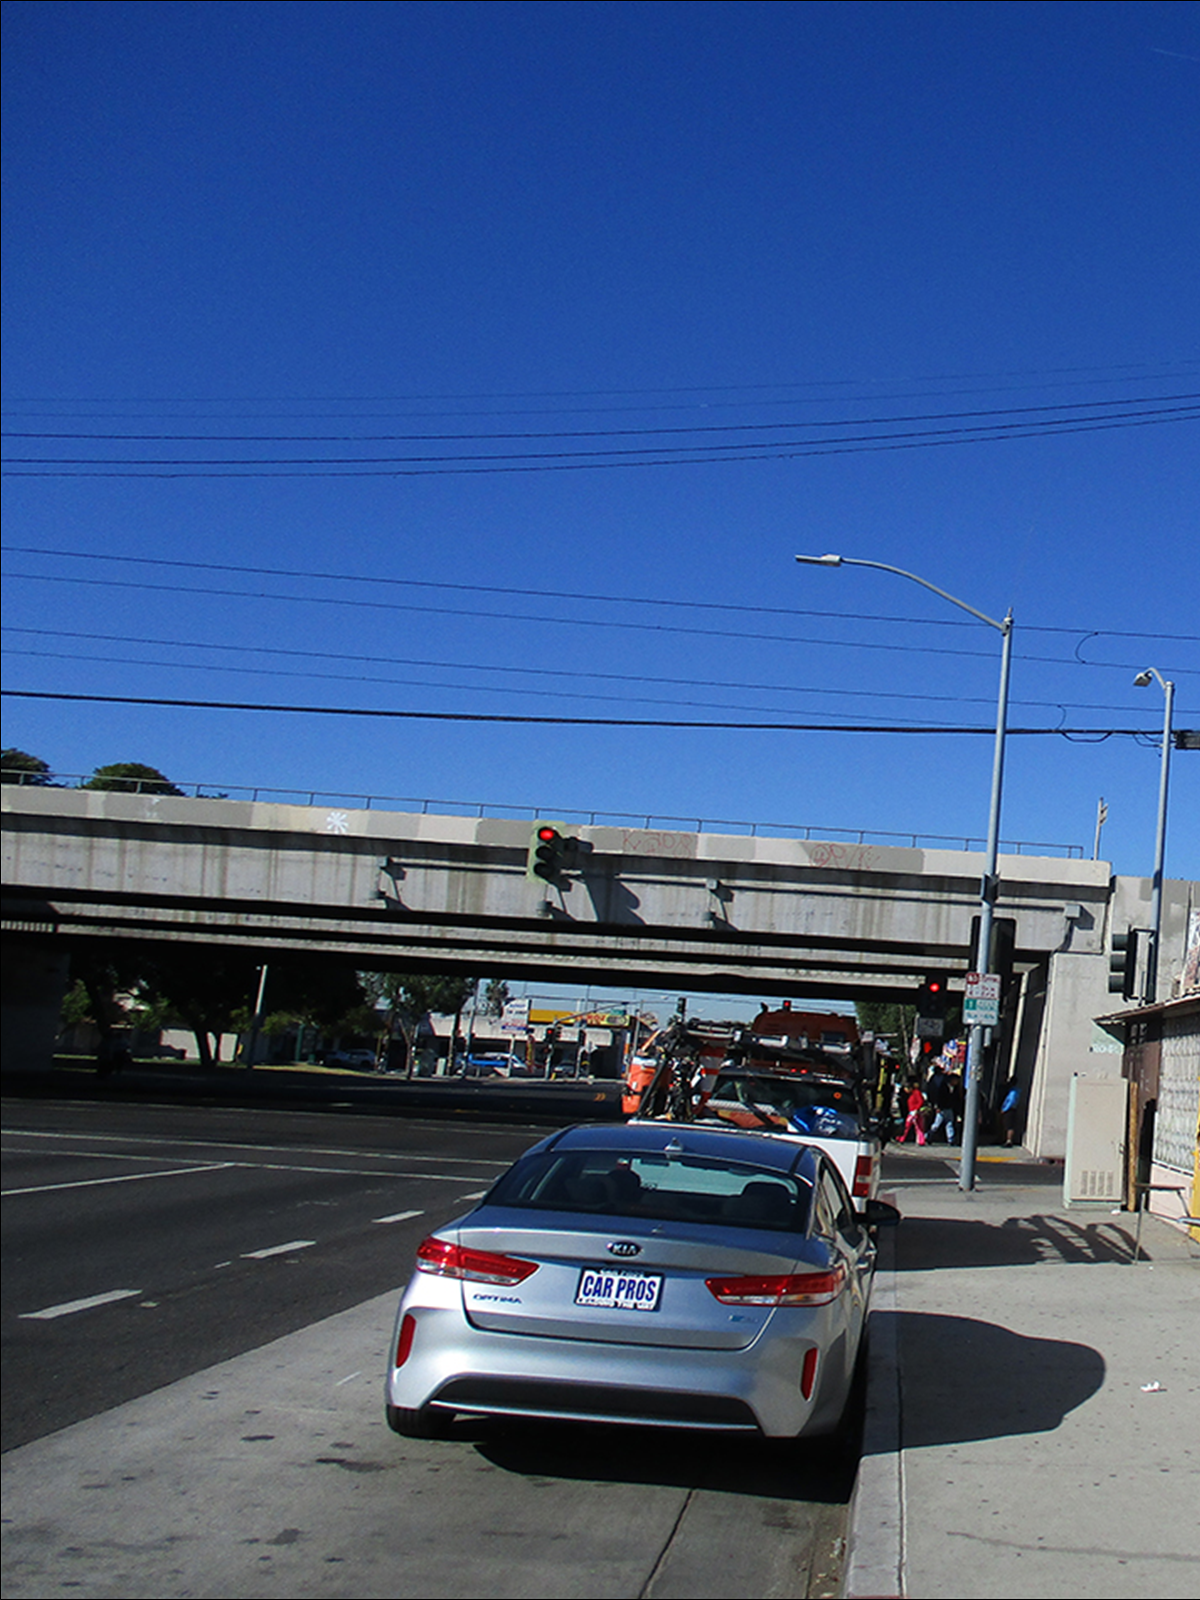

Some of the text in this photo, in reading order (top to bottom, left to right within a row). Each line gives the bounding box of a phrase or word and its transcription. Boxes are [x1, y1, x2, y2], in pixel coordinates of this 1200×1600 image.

[612, 1243, 637, 1255] KIA
[582, 1275, 657, 1302] CAR PROS
